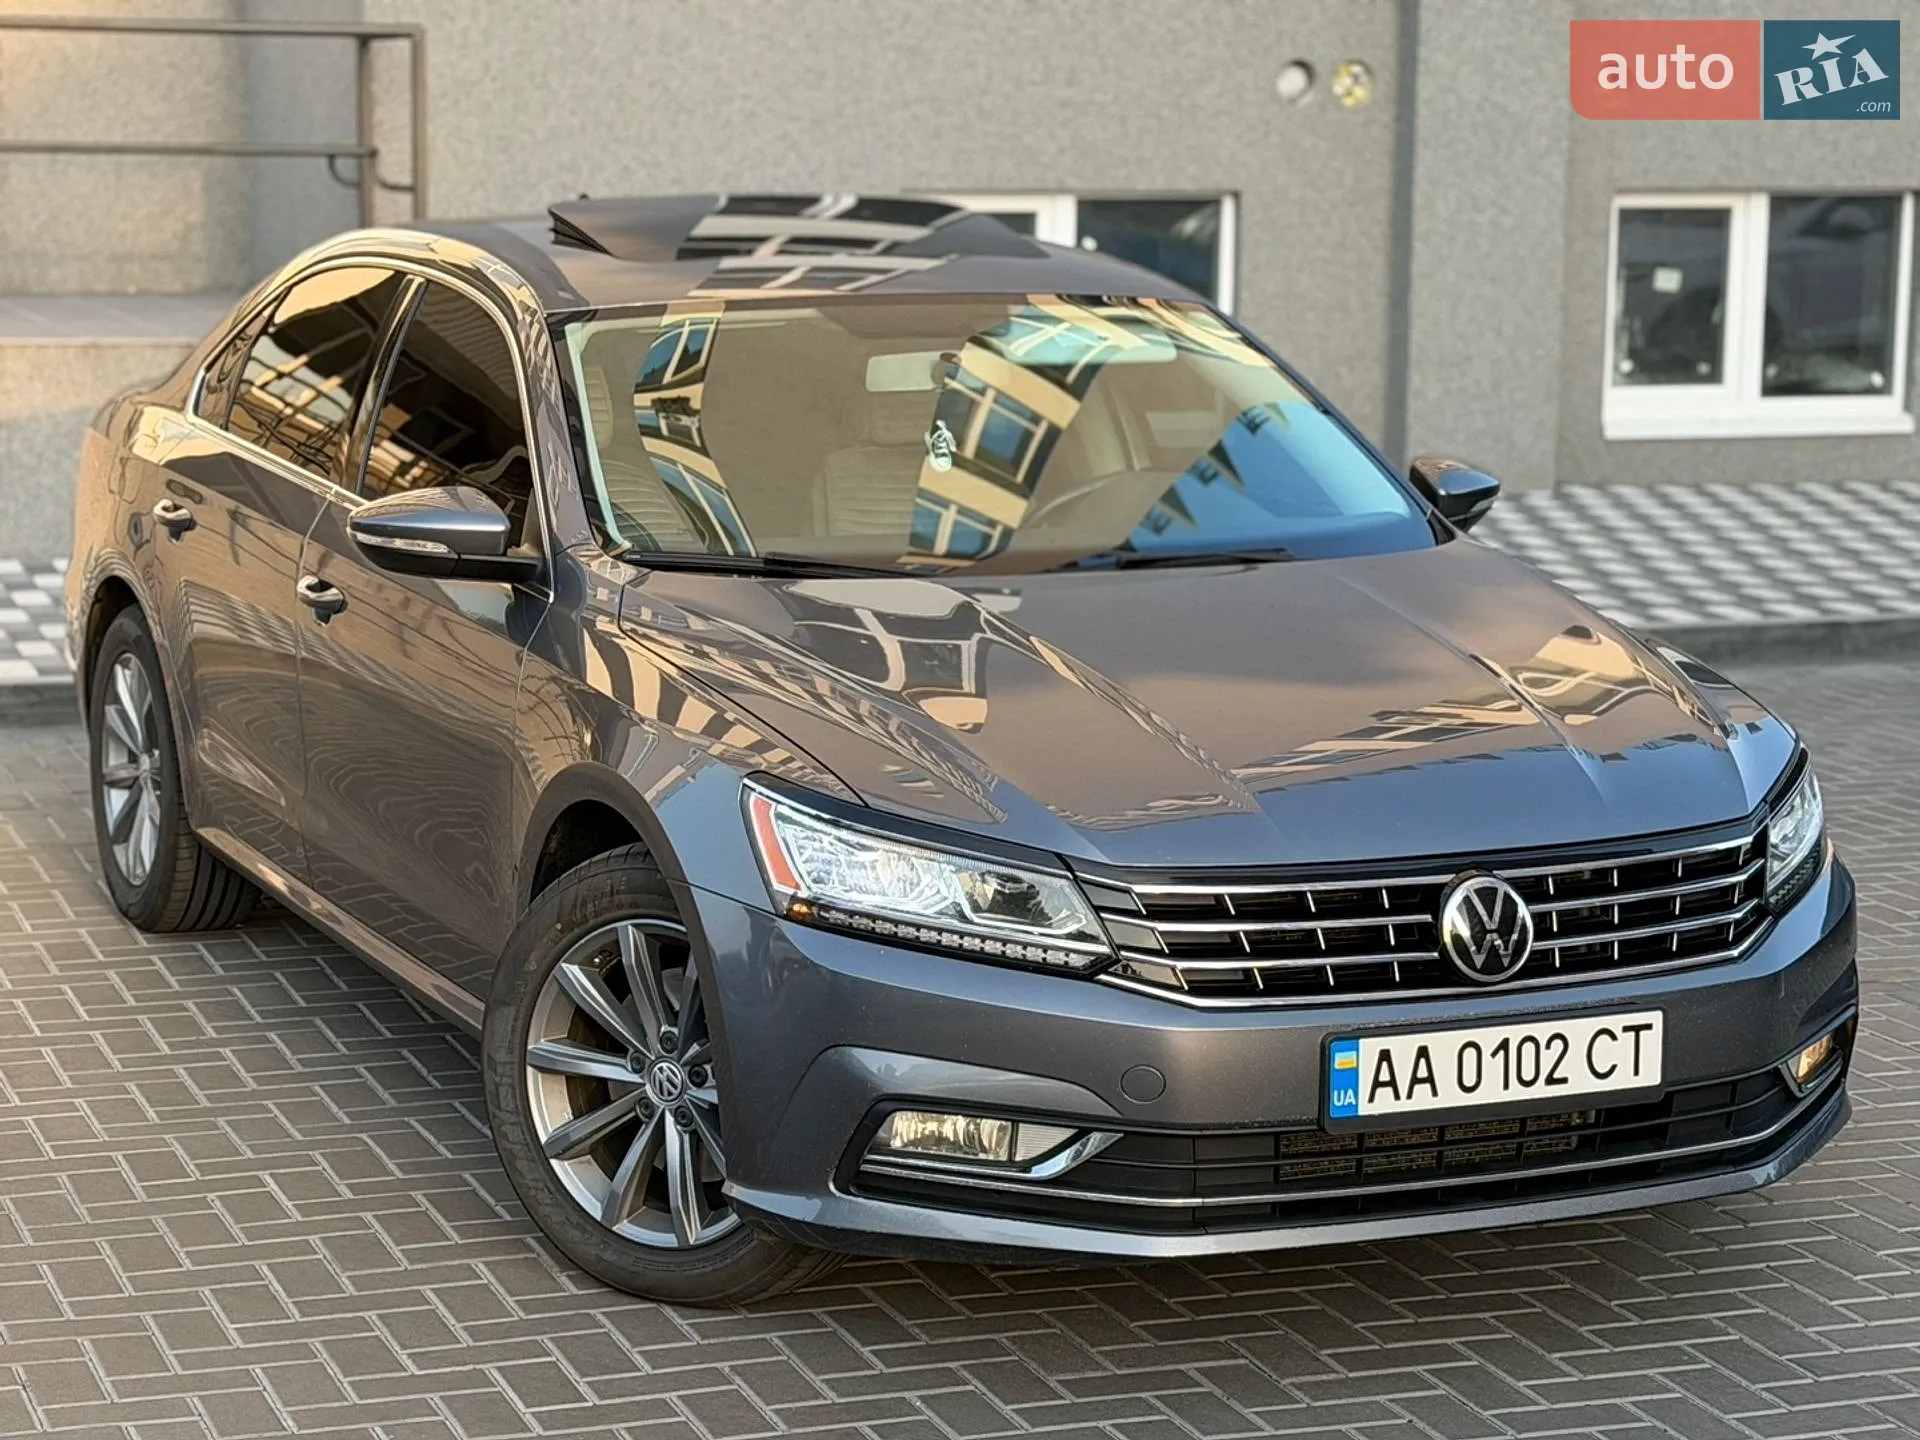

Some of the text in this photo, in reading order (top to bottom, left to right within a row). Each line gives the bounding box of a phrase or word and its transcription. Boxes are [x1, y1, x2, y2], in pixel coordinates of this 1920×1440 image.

[1367, 1023, 1653, 1104] AA 0102 CT
[1333, 1088, 1356, 1106] UA
